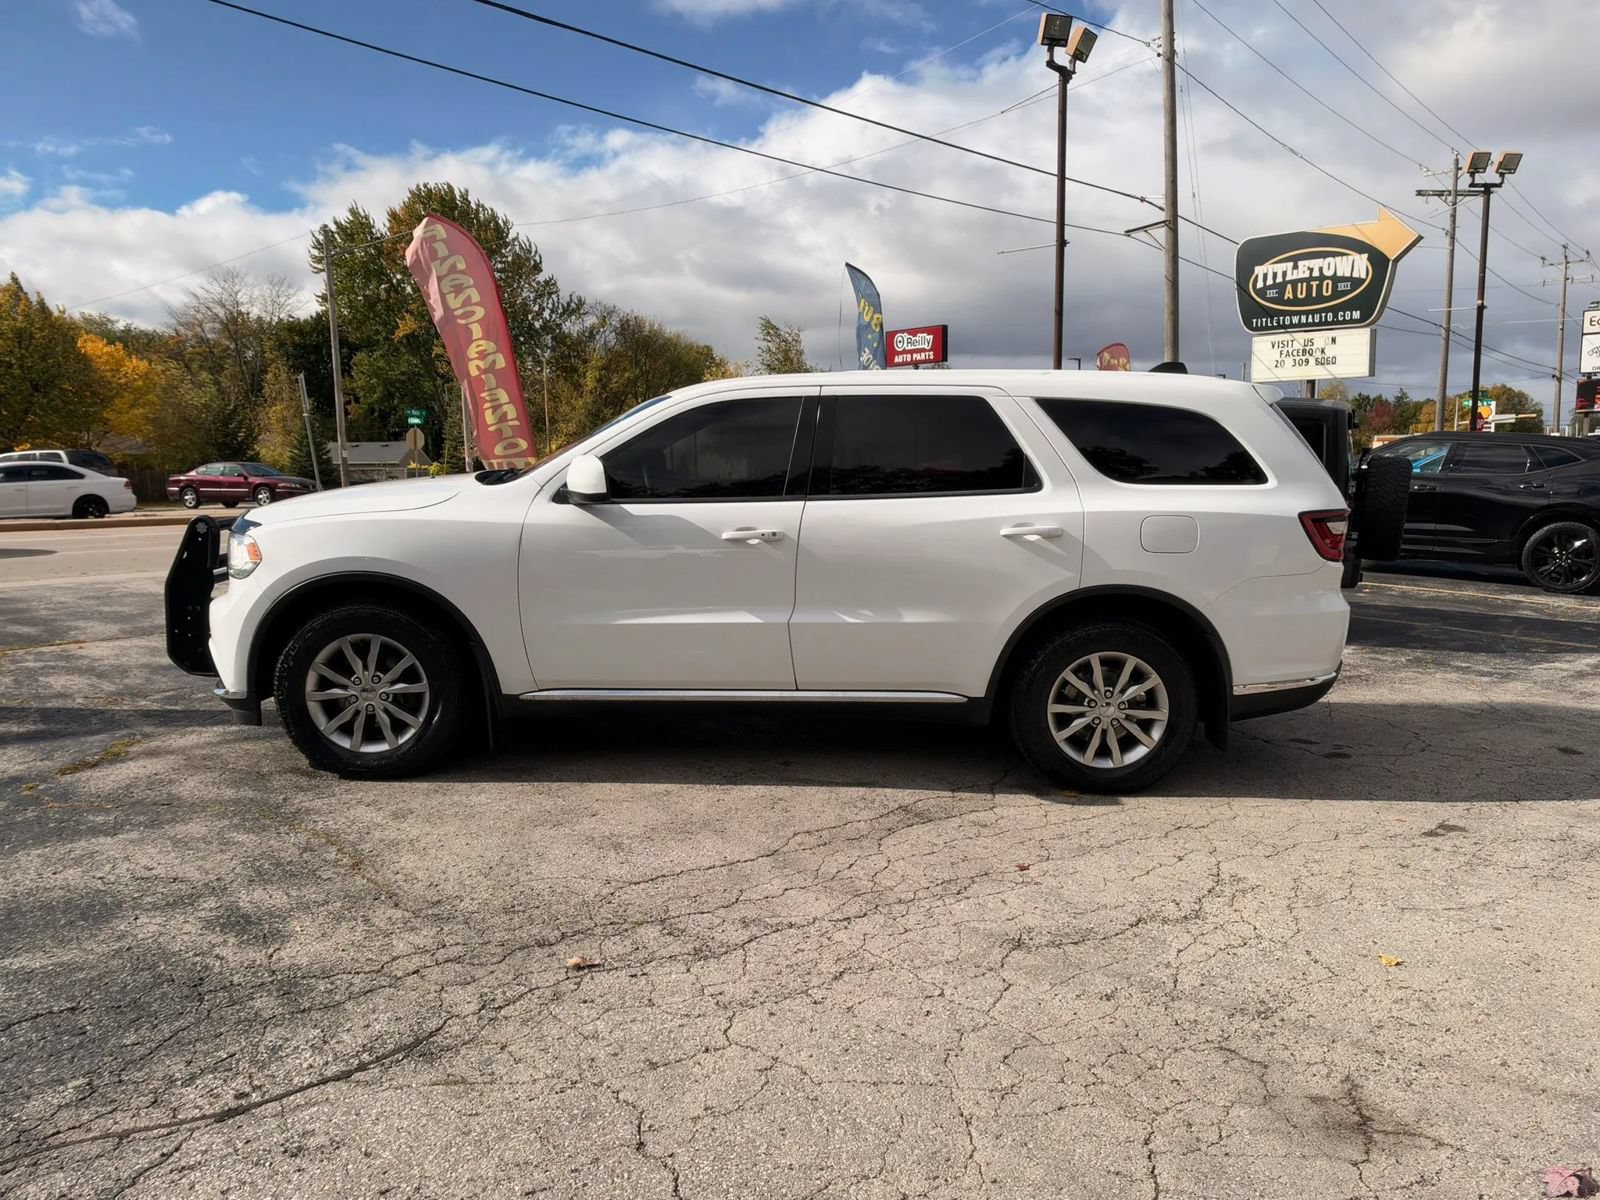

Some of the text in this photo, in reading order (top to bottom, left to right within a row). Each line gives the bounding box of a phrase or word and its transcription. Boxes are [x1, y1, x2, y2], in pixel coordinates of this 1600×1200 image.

[1254, 253, 1369, 289] TITLETOWN
[1284, 280, 1332, 300] AUTO
[1252, 310, 1361, 328] TITLETOWNAUTO.COM
[895, 333, 933, 350] O'Reilly
[1270, 339, 1296, 350] VISIT
[1303, 337, 1315, 348] US
[893, 353, 912, 363] AUTO
[912, 351, 935, 362] PARTS
[1279, 346, 1327, 359] FACEBOOK
[1291, 357, 1310, 368] 309
